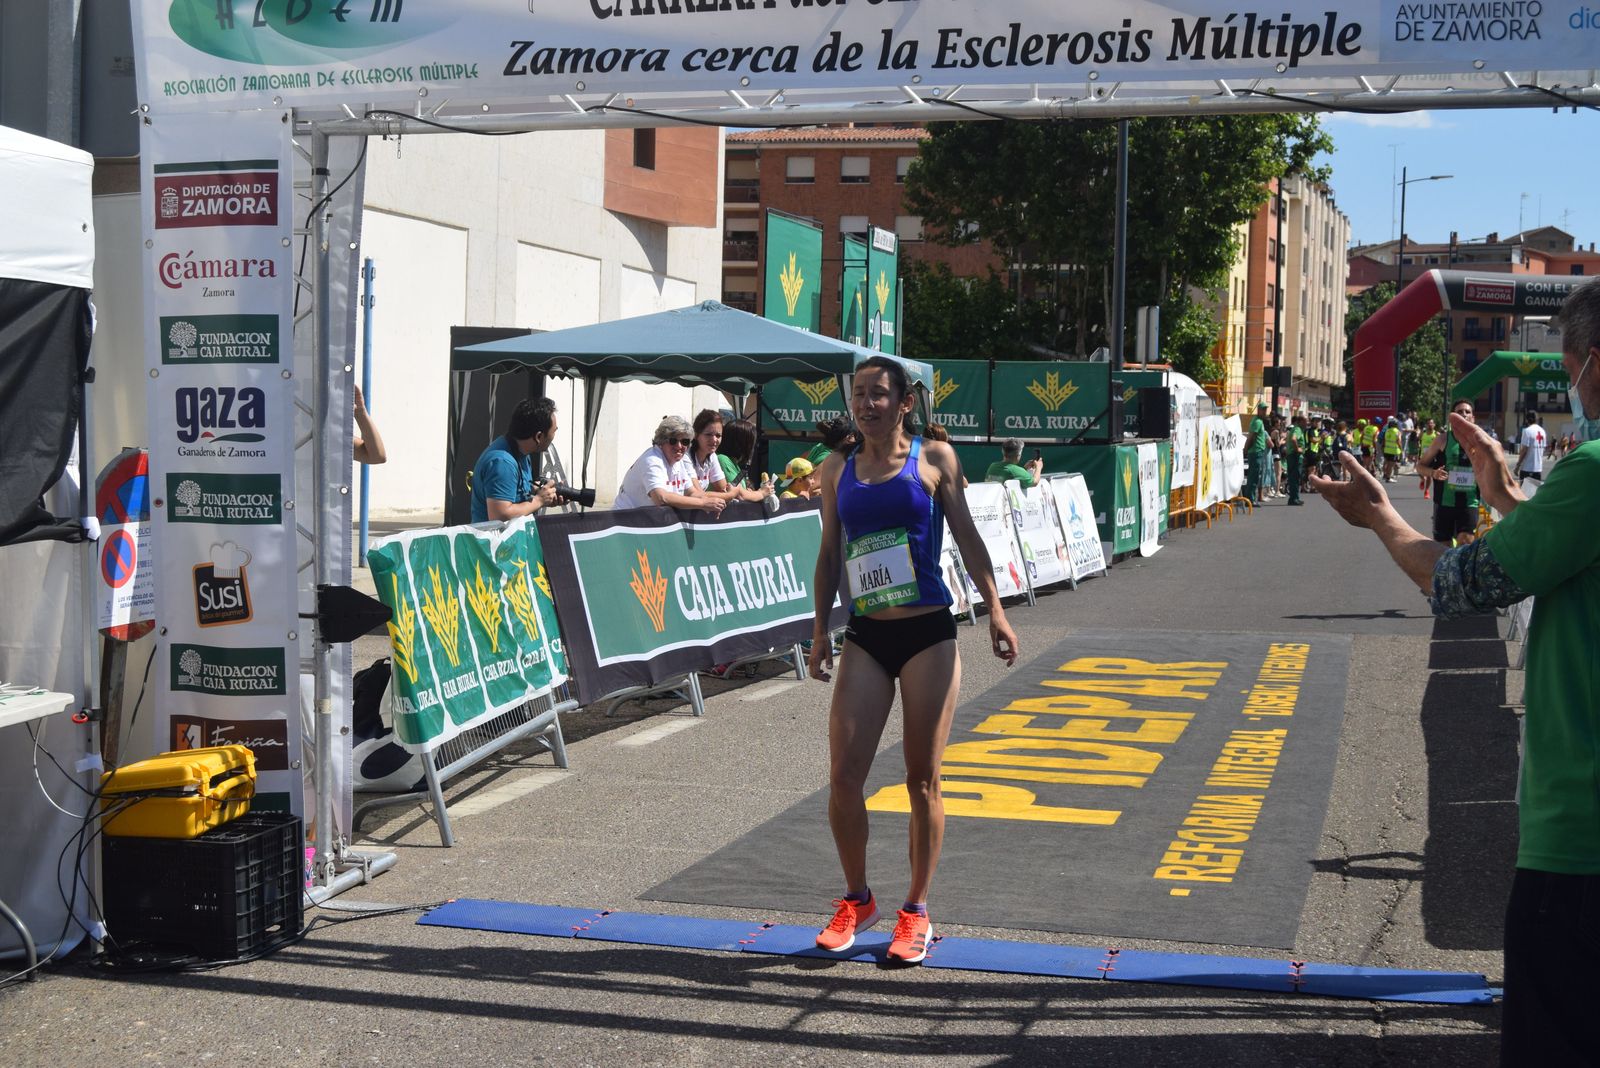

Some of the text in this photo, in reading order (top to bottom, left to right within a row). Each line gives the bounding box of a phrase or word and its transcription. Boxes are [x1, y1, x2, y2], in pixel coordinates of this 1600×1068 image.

[1396, 1, 1542, 20] AYUNTAMIENTO
[1395, 20, 1541, 41] DE ZAMORA
[503, 11, 1362, 77] Zamora cerca de la Esclerosis Múltiple
[163, 61, 479, 96] ASOCIACIÓN ZAMORANA DE ESCLEROSIS MÚLTIPLE
[182, 182, 270, 197] DIPUTACIÓN DE
[182, 196, 271, 217] ZAMORA
[202, 287, 235, 297] Zamora
[1526, 282, 1551, 293] CON
[1554, 283, 1568, 293] EL
[1476, 292, 1511, 300] ZAMORA
[199, 332, 271, 345] FUNDACION
[200, 346, 271, 358] CAJA RURAL
[175, 387, 266, 443] gaza
[773, 408, 806, 423] CAJA
[1005, 416, 1100, 429] CAJA RURAL
[178, 446, 266, 457] Ganaderos de Zamora
[202, 493, 273, 506] FUNDACION
[202, 506, 273, 518] CAJA RURAL
[872, 539, 898, 550] RURAL
[859, 563, 893, 592] MARÍA
[199, 579, 243, 611] Susi
[674, 553, 807, 622] CAJA RURAL
[867, 588, 915, 606] CAJA RURAL
[203, 664, 277, 678] FUNDACION
[203, 677, 277, 690] CAJA RURAL
[211, 725, 284, 747] Fariña
[1205, 729, 1288, 788] INTEGRAL
[1153, 794, 1265, 882] REFORMA
